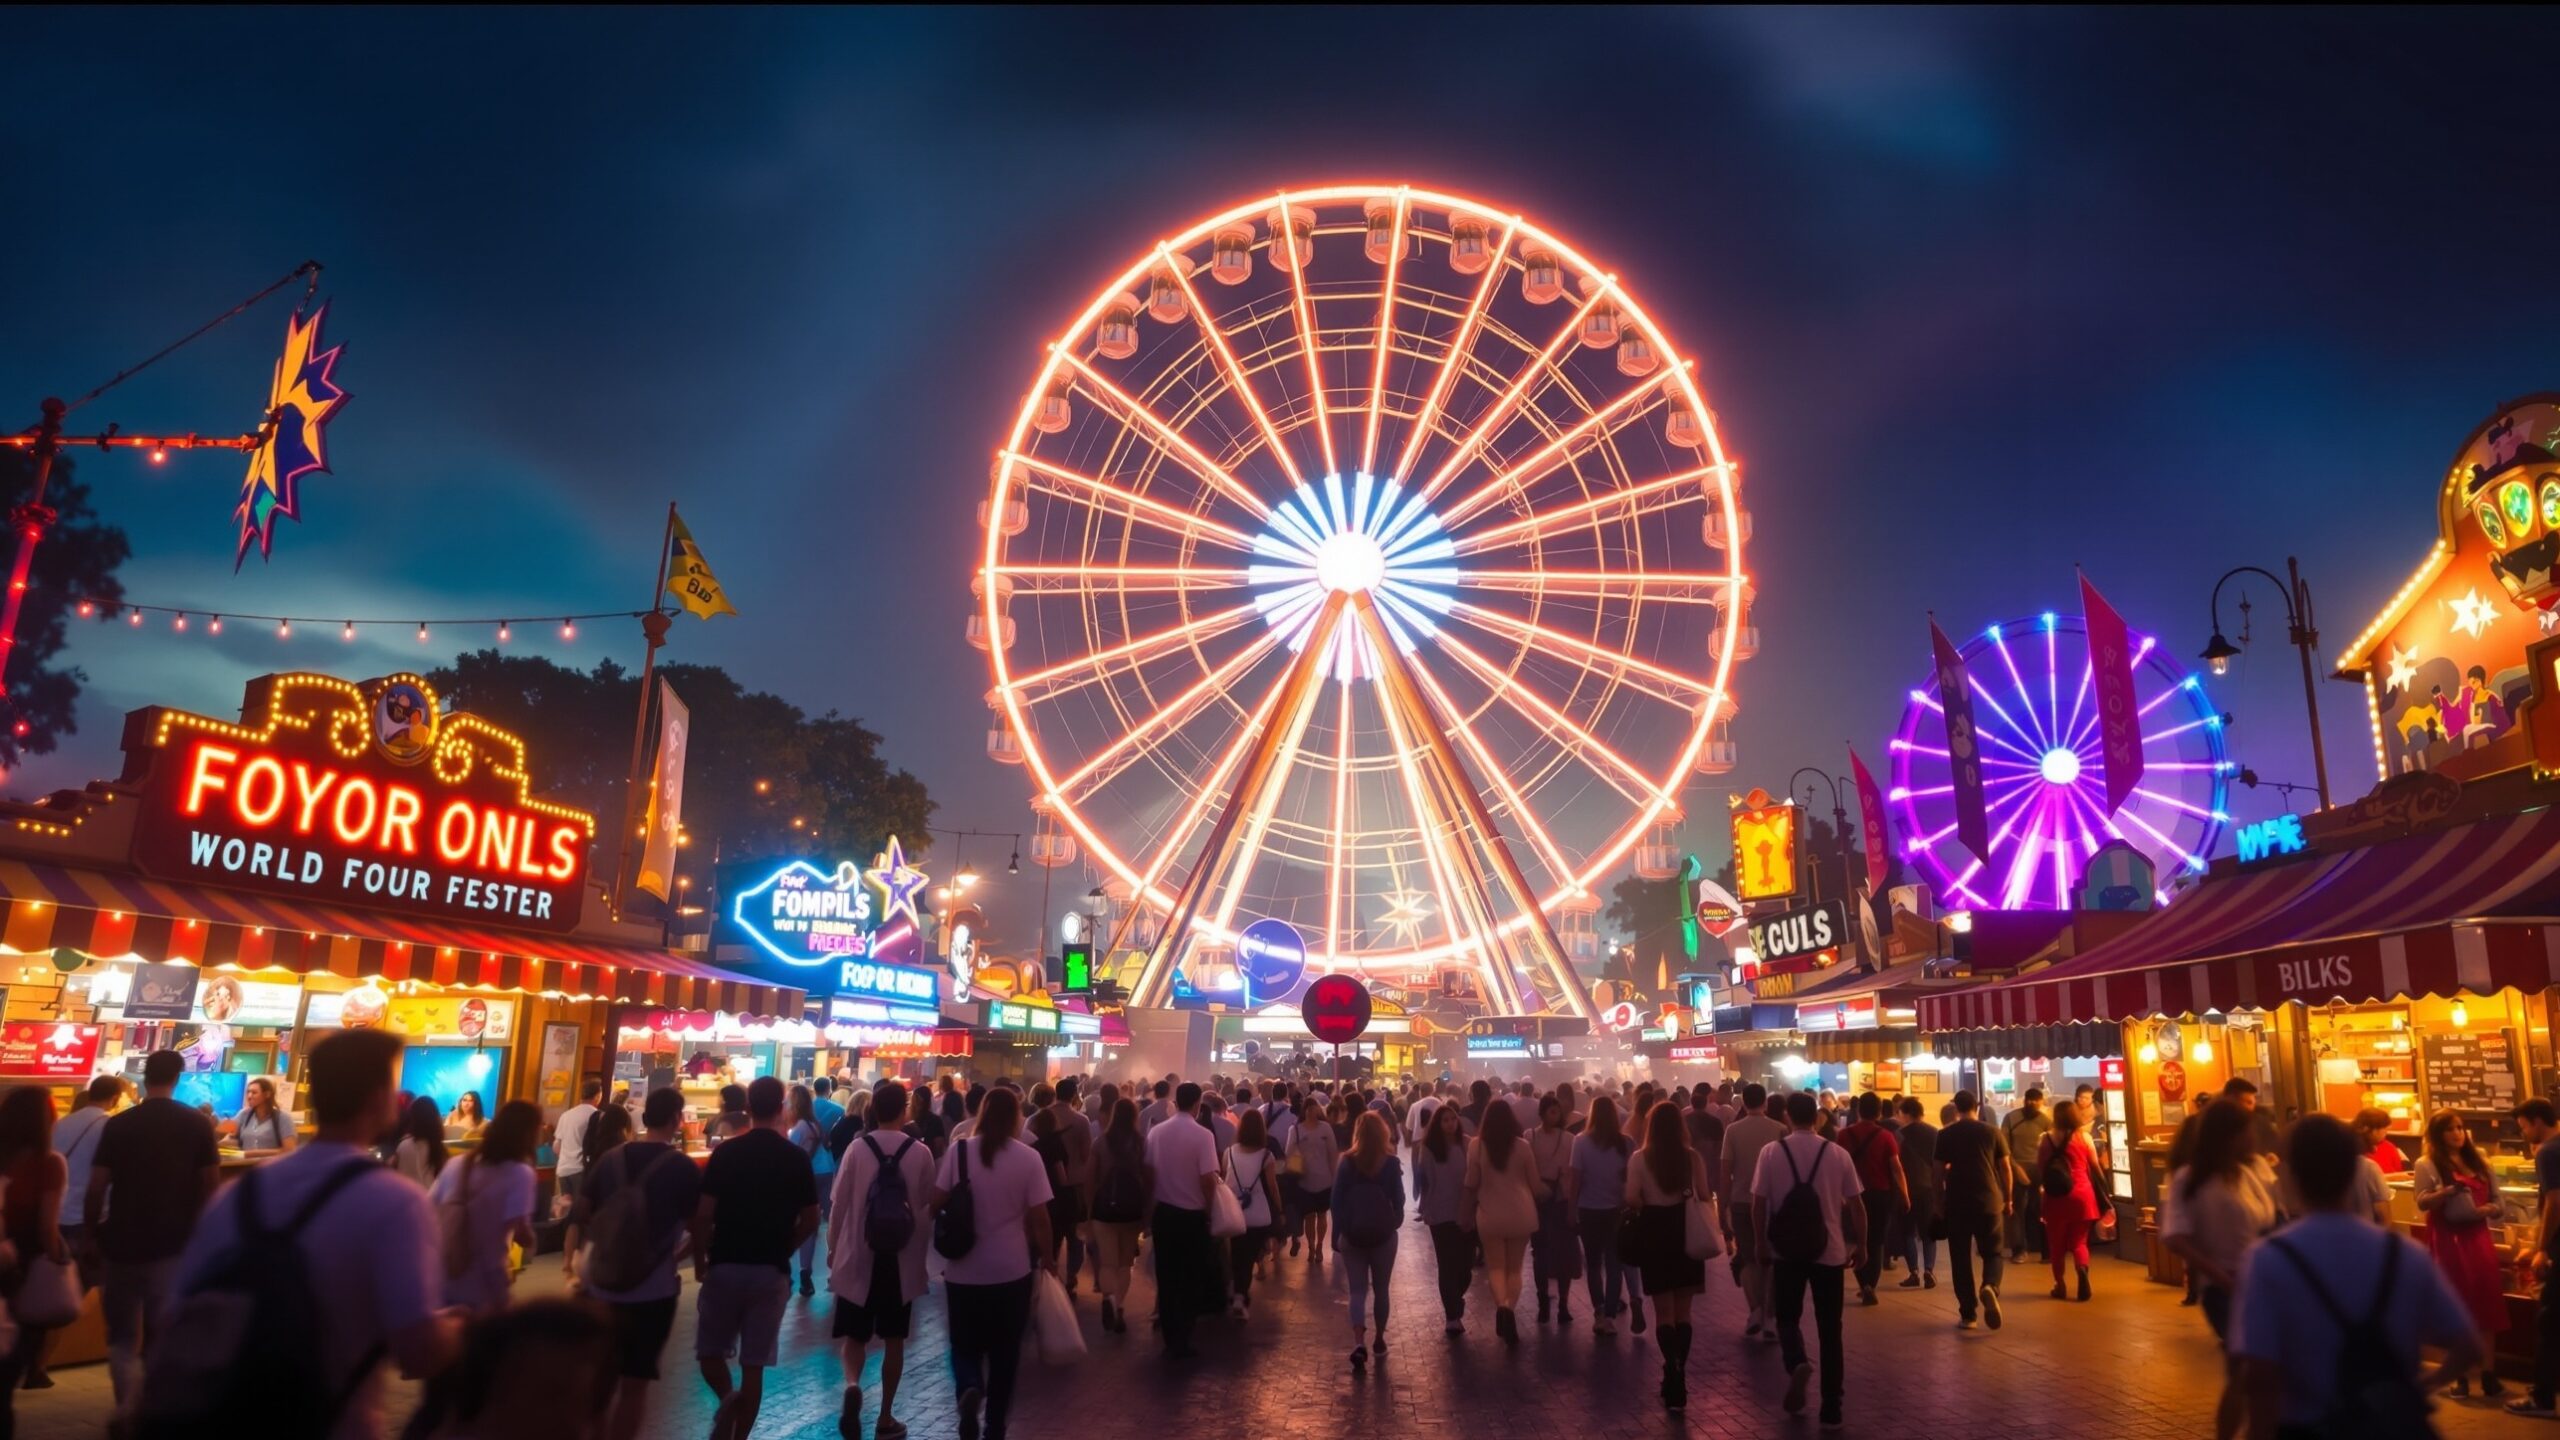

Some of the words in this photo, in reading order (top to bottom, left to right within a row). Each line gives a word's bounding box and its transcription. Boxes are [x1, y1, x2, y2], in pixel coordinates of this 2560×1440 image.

[185, 746, 421, 852] FOYOR
[438, 802, 578, 879] ONLS
[191, 831, 322, 884] WORLD
[342, 858, 431, 901] FOUR
[446, 876, 552, 919] FESTER
[773, 890, 871, 919] FOMPILS
[1769, 910, 1831, 956] CULS
[2278, 956, 2353, 992] BILKS
